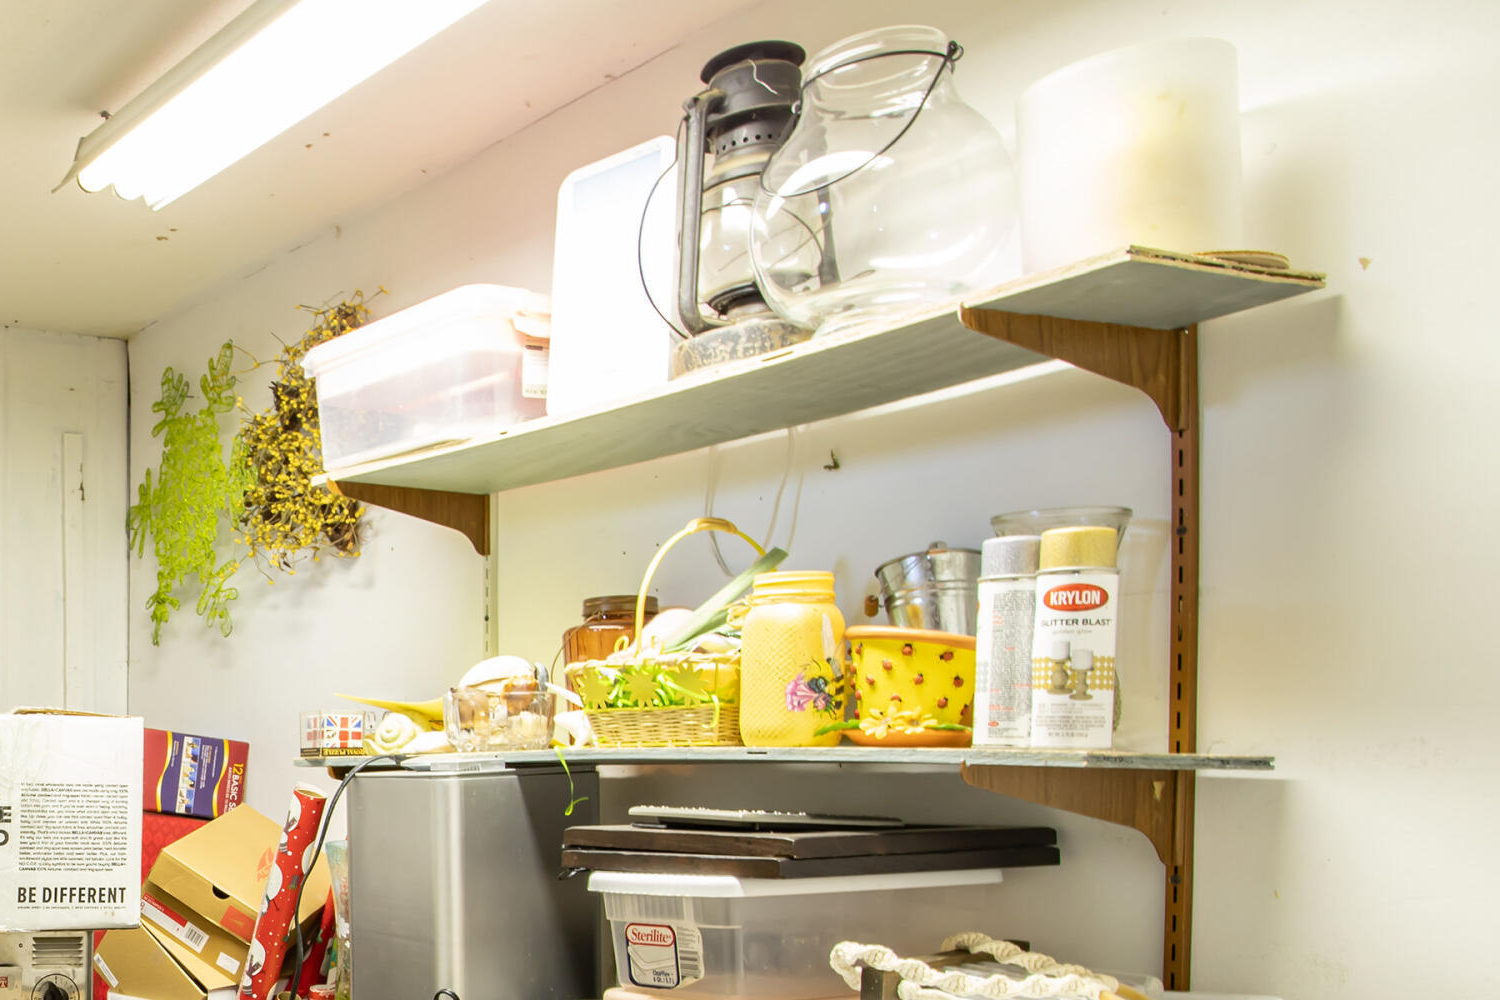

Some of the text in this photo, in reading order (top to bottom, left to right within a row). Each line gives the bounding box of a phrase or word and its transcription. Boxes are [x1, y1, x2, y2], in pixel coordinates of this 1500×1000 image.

[1050, 591, 1100, 605] KRYLON
[230, 763, 244, 800] 12 BASIC
[18, 887, 126, 903] BE DIFFERENT
[631, 927, 671, 943] Sterilite
